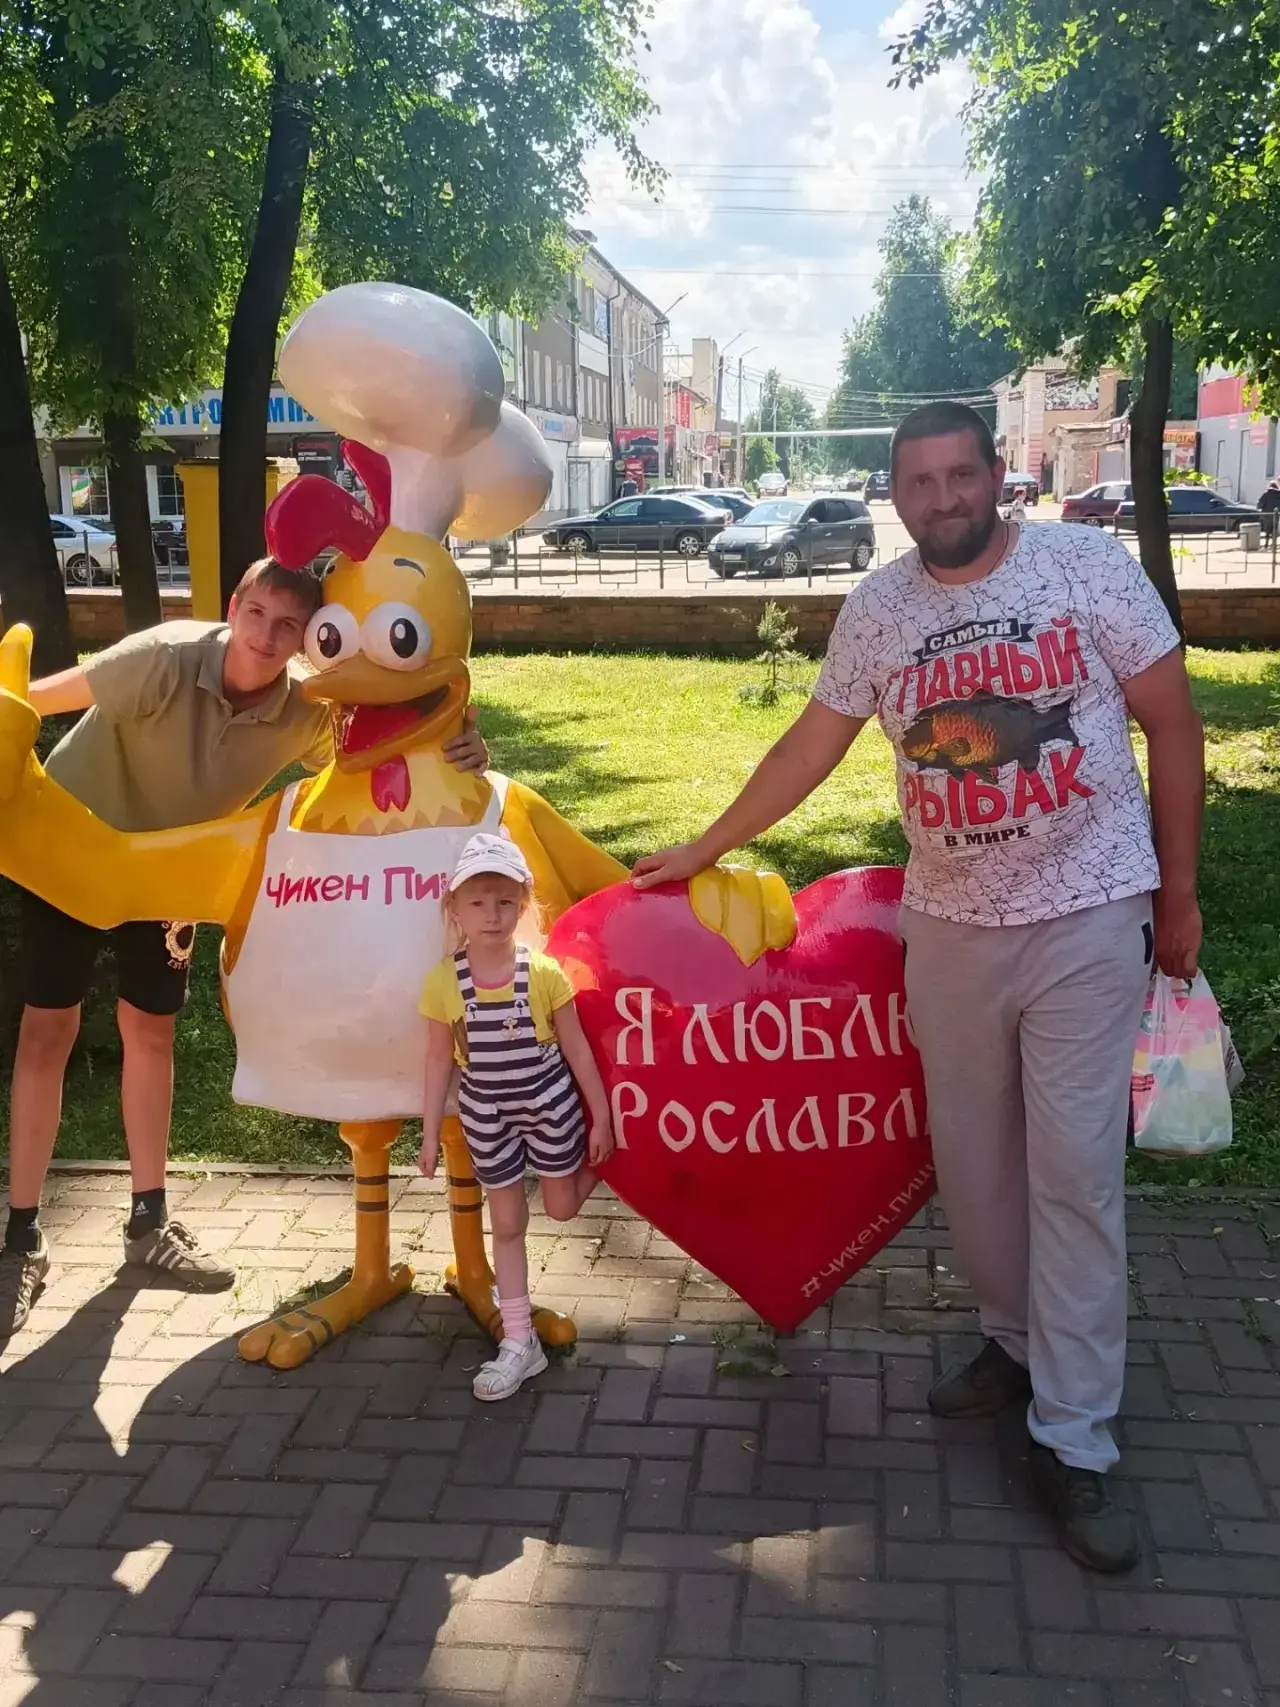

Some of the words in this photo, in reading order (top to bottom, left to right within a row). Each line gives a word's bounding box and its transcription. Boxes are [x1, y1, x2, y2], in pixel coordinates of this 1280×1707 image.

[929, 620, 1013, 651] САМЫЙ
[904, 747, 1097, 828] РЫБАК
[944, 835, 959, 847] В
[966, 825, 1031, 847] МИРЕ
[383, 866, 448, 905] Пи
[614, 986, 657, 1066] Я
